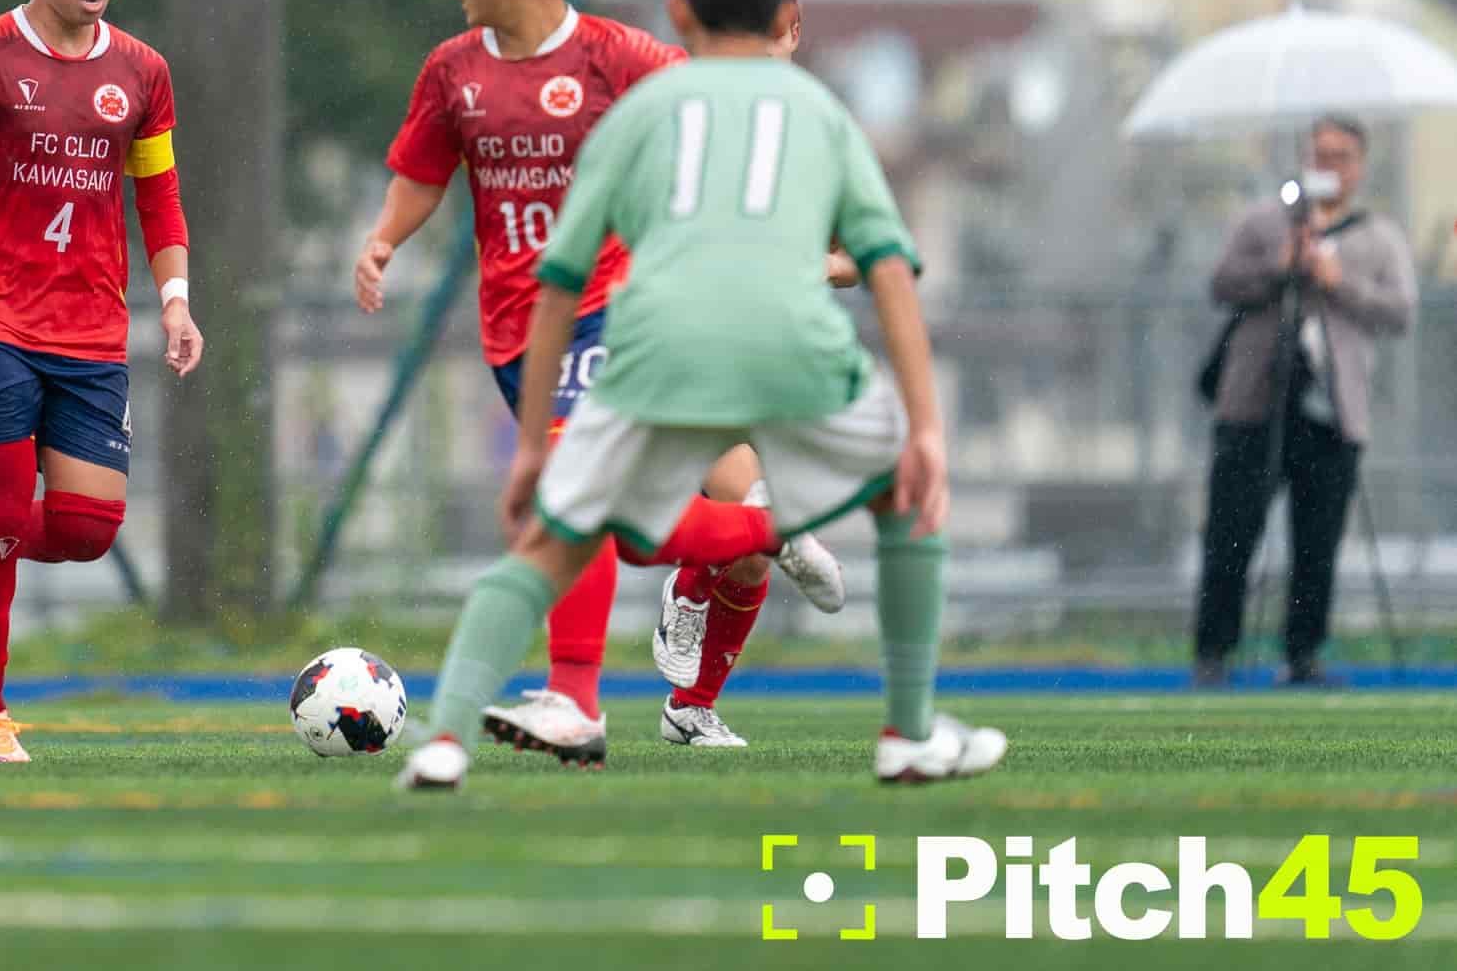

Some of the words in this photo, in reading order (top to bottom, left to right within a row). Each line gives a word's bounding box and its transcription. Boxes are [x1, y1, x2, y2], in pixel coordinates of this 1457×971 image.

[31, 132, 59, 155] FC
[64, 135, 110, 159] CLIO
[477, 136, 505, 159] FC
[511, 133, 565, 158] CLIO
[669, 98, 785, 215] 11
[13, 161, 114, 192] KAWASAKI
[44, 201, 75, 253] 4
[499, 200, 556, 254] 10
